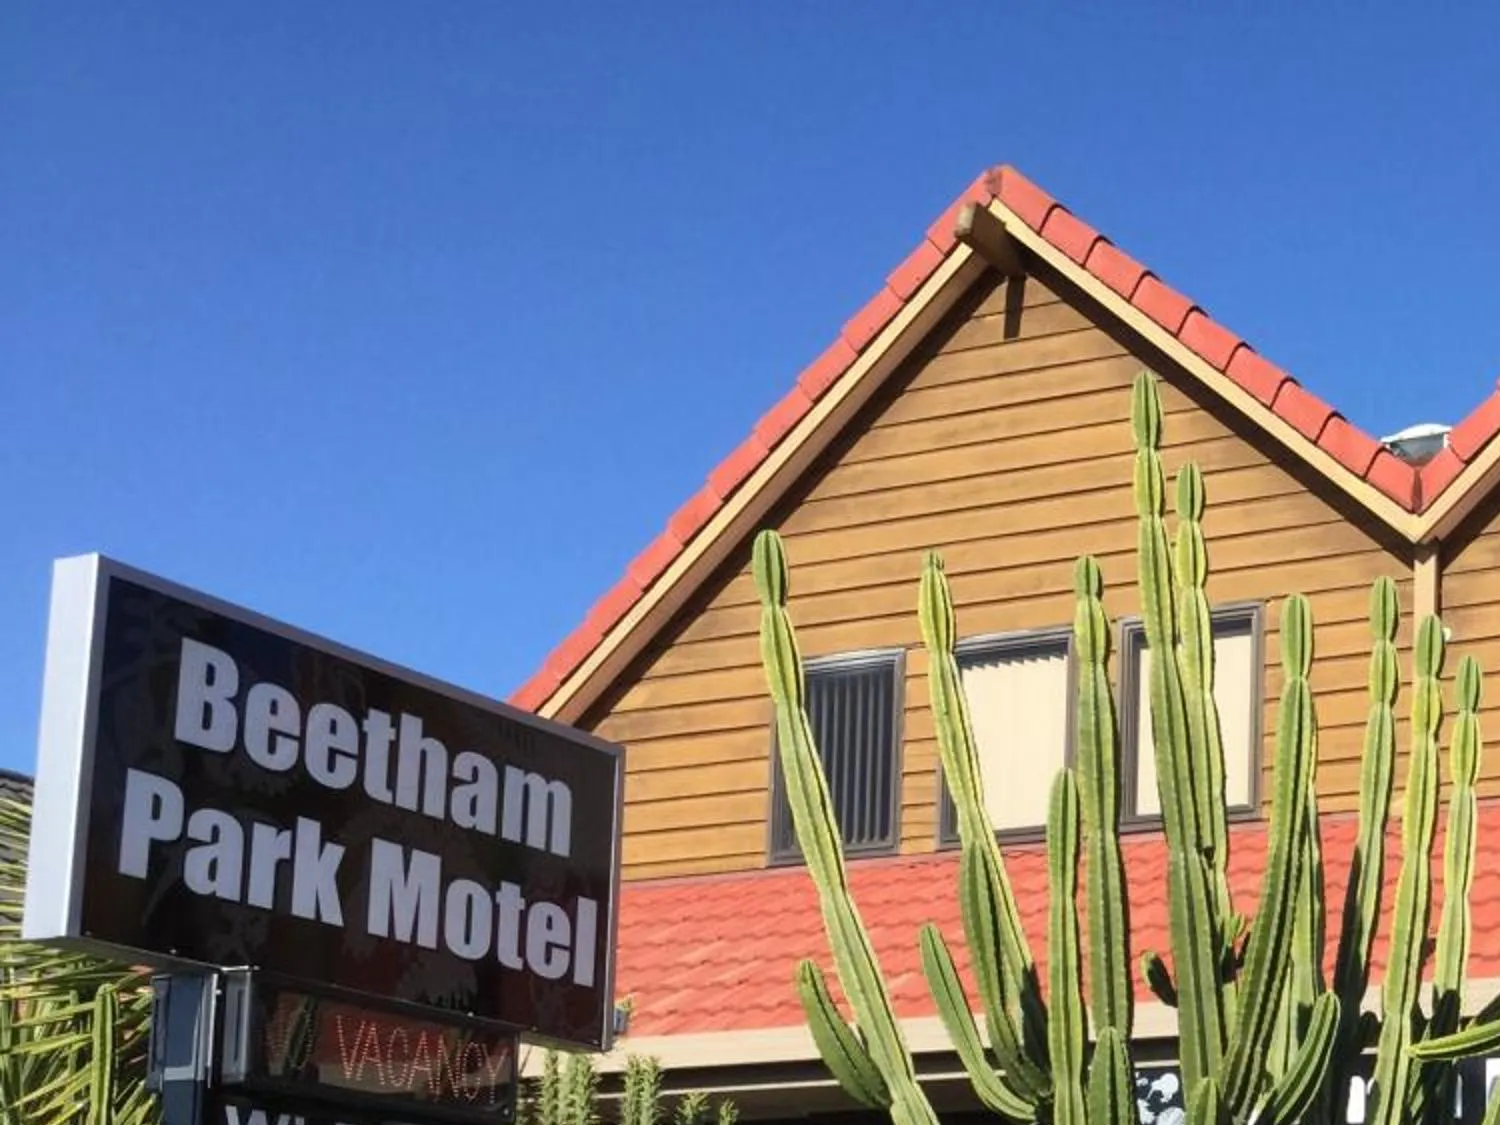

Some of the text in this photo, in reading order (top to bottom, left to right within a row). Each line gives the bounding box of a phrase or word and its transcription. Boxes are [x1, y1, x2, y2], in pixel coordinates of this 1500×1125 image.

[173, 636, 573, 857] Beetham
[118, 767, 598, 987] Park Motel
[336, 1013, 510, 1105] VACANCY
